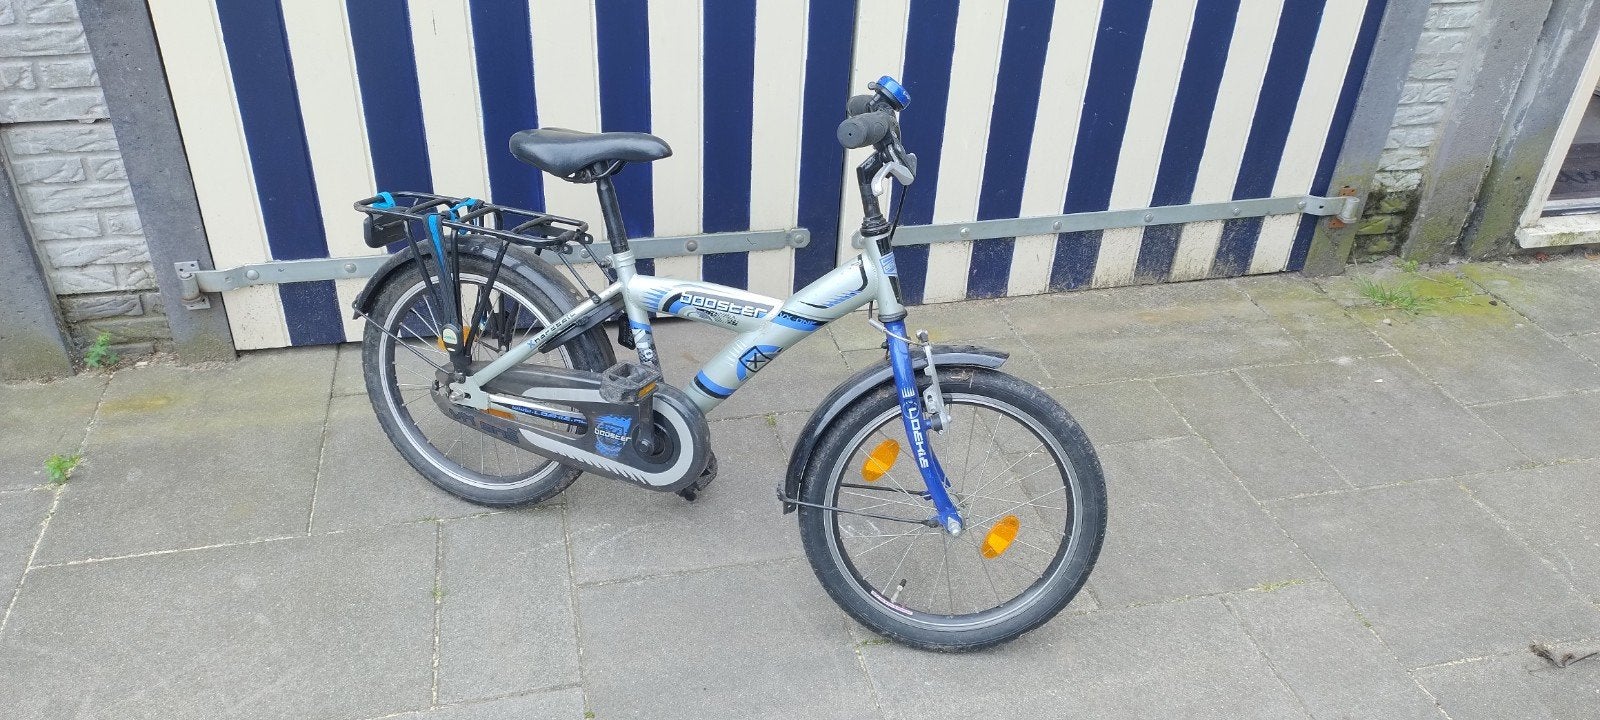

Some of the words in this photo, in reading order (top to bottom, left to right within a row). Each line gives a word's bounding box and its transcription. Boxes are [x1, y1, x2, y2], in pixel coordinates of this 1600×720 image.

[680, 292, 768, 319] booster
[594, 427, 632, 442] booster
[908, 407, 929, 469] LOEKIE
